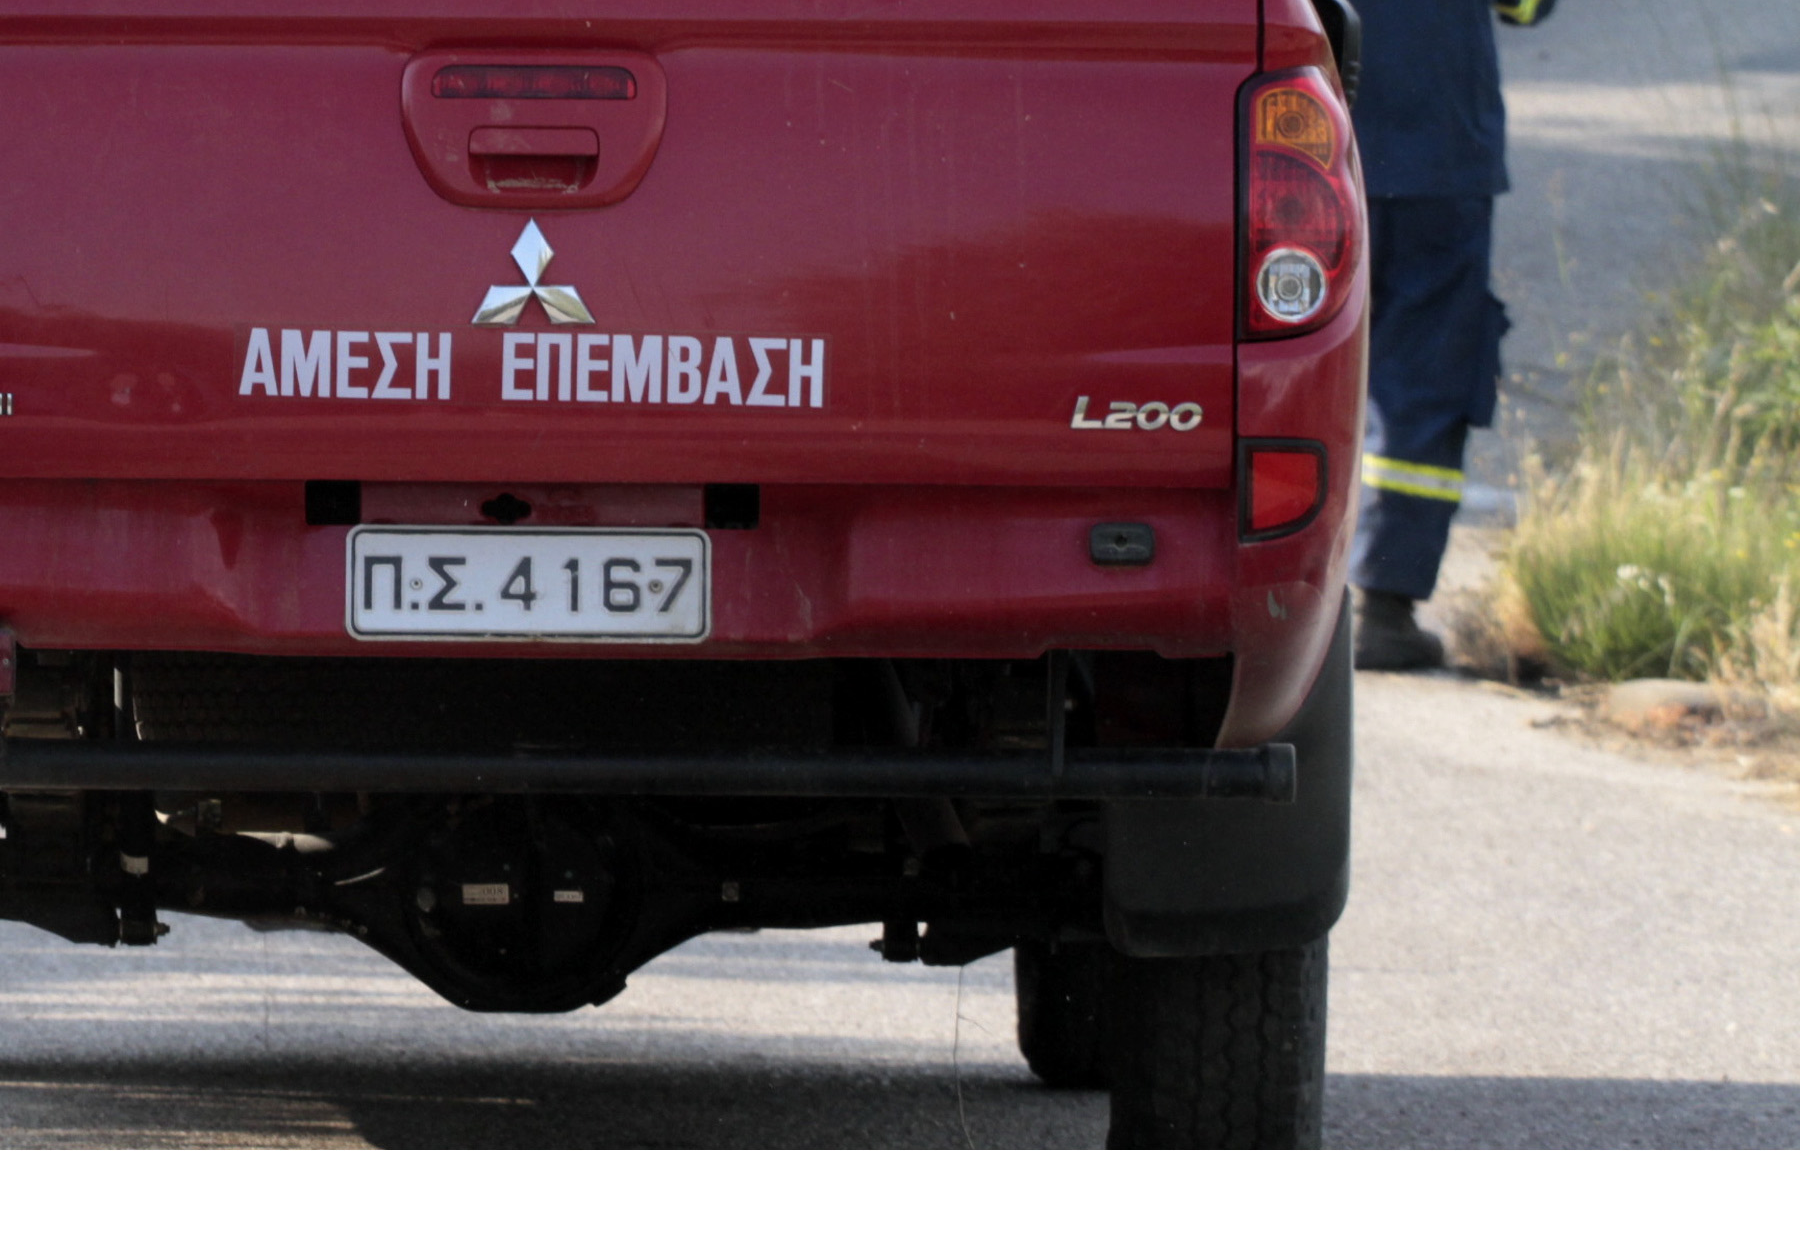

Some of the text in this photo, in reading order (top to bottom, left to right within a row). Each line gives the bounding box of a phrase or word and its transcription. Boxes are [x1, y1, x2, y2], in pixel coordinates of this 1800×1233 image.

[238, 327, 825, 408] ΑΜΕΣΗ ΕΠΕΜΒΑΣΗ
[1070, 395, 1203, 432] L200
[500, 556, 693, 613] 4167
